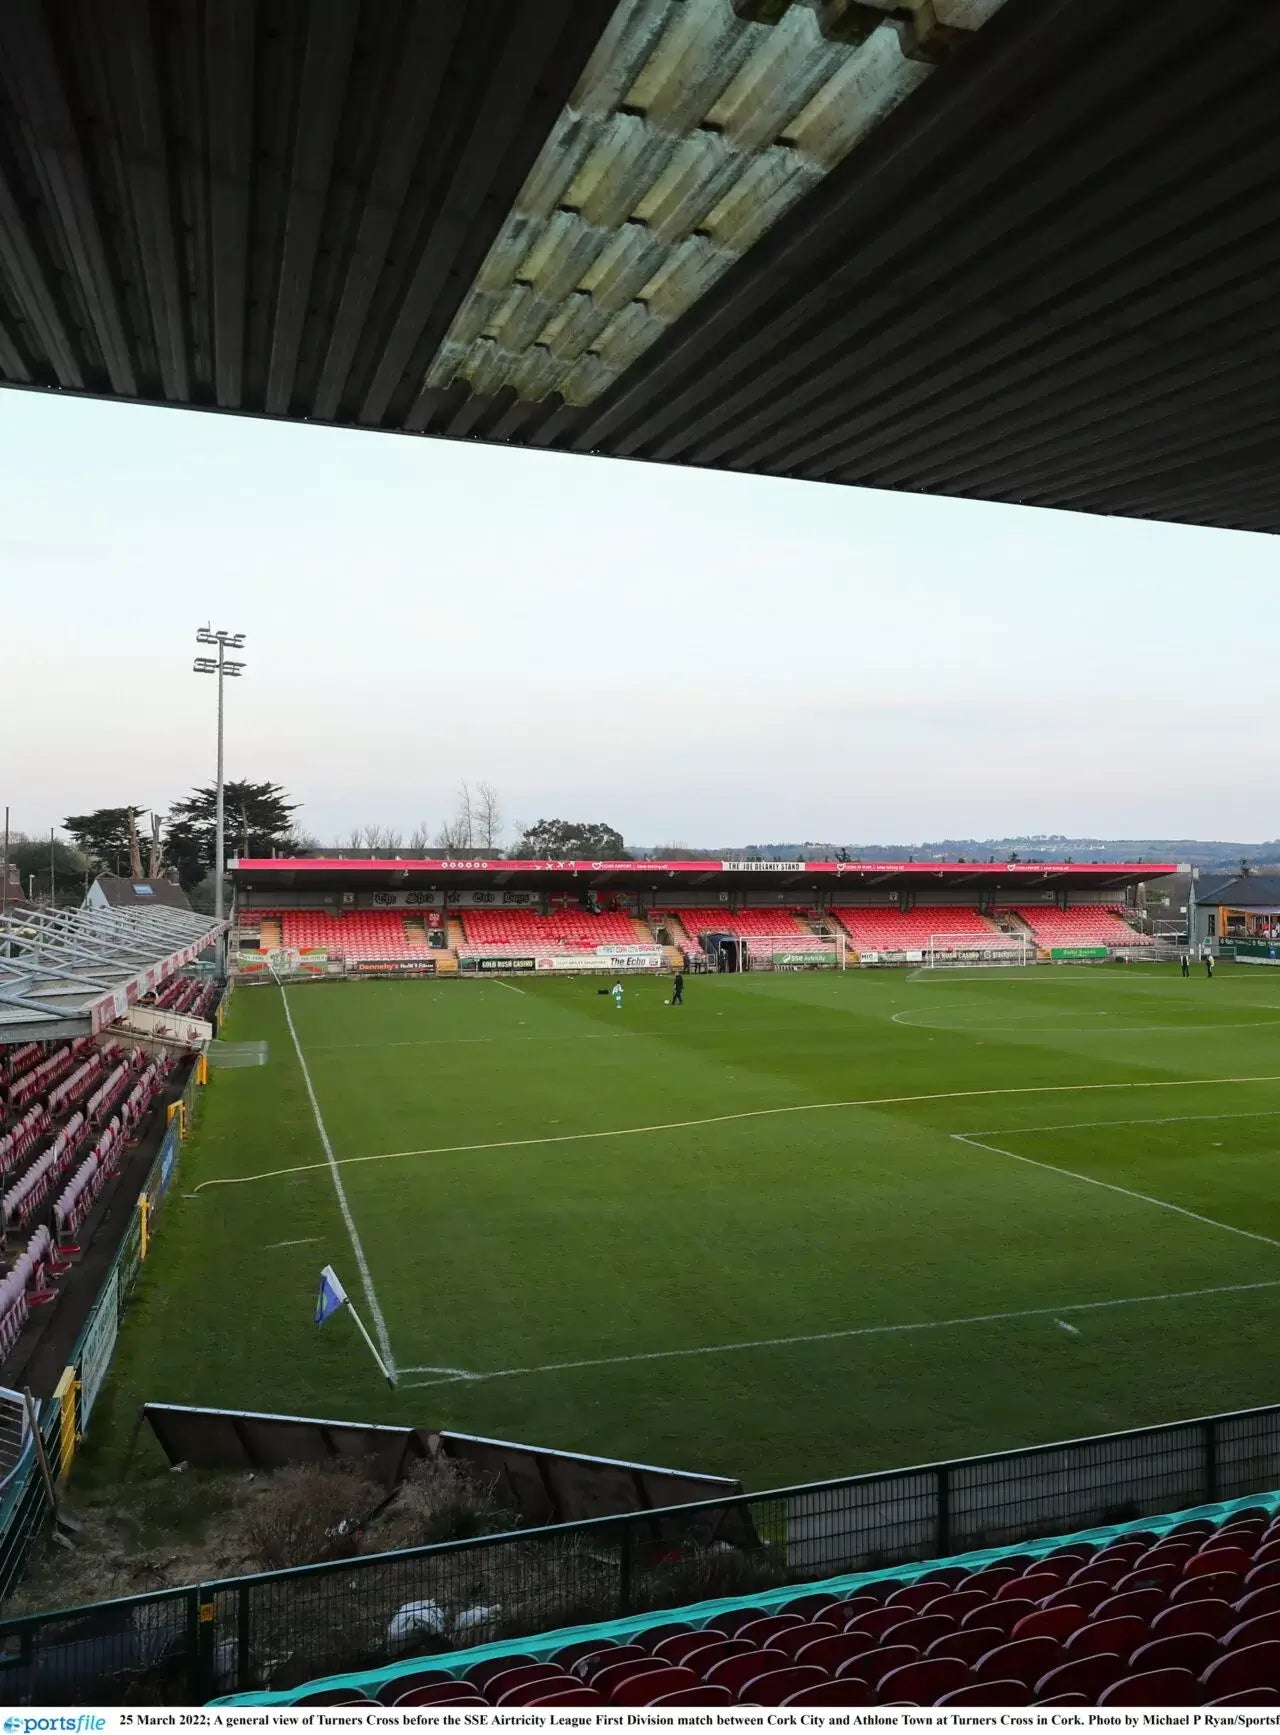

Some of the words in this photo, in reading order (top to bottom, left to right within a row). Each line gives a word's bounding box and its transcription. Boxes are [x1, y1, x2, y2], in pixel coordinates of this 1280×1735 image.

[728, 862, 740, 870] THE
[743, 862, 753, 870] JOE
[754, 862, 780, 871] DELANEY
[781, 863, 800, 871] STAND
[482, 960, 497, 969] GOLD
[497, 960, 512, 968] RUSH
[513, 960, 533, 968] CASINO
[610, 957, 625, 966] The
[626, 957, 646, 966] Echo
[359, 963, 399, 971] Dennehy's
